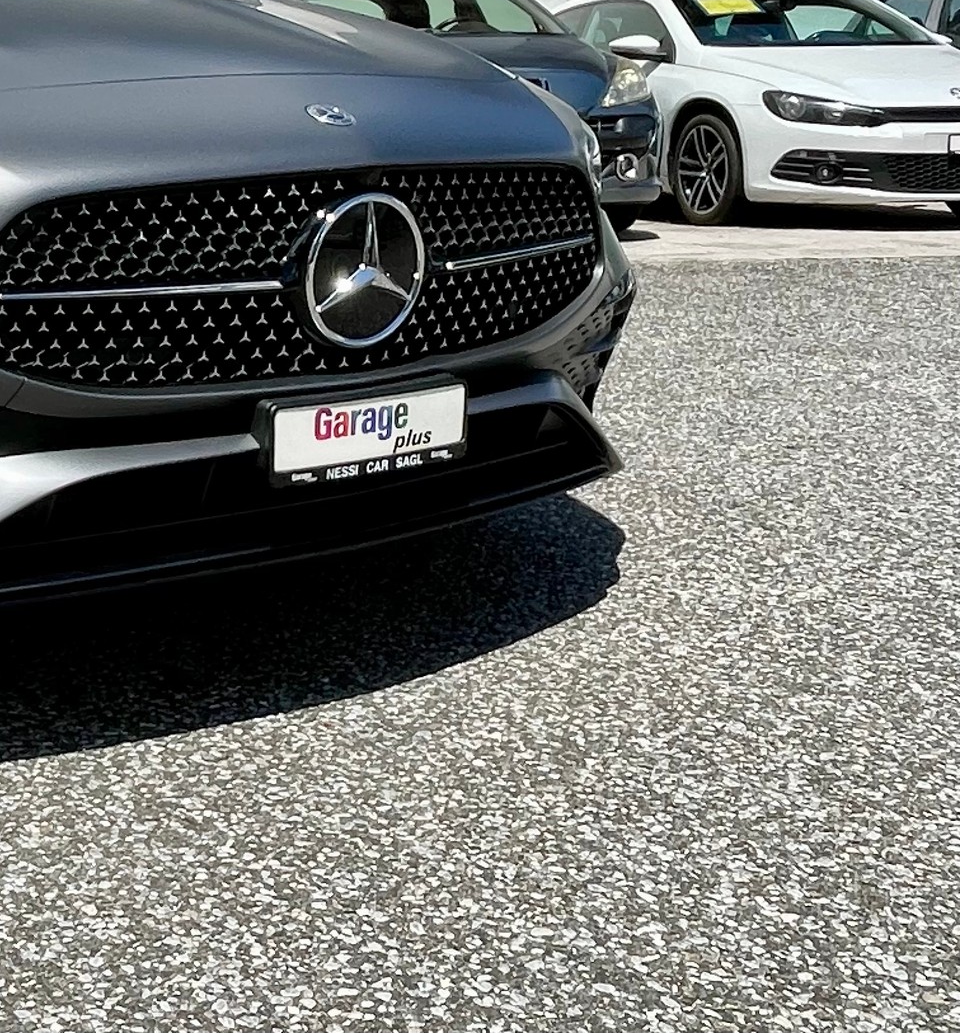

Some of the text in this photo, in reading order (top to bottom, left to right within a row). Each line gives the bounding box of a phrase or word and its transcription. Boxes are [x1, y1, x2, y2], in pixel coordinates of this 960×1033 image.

[314, 402, 409, 441] Garage
[393, 429, 432, 453] plus
[326, 454, 423, 480] NESSI CAR SAGL
